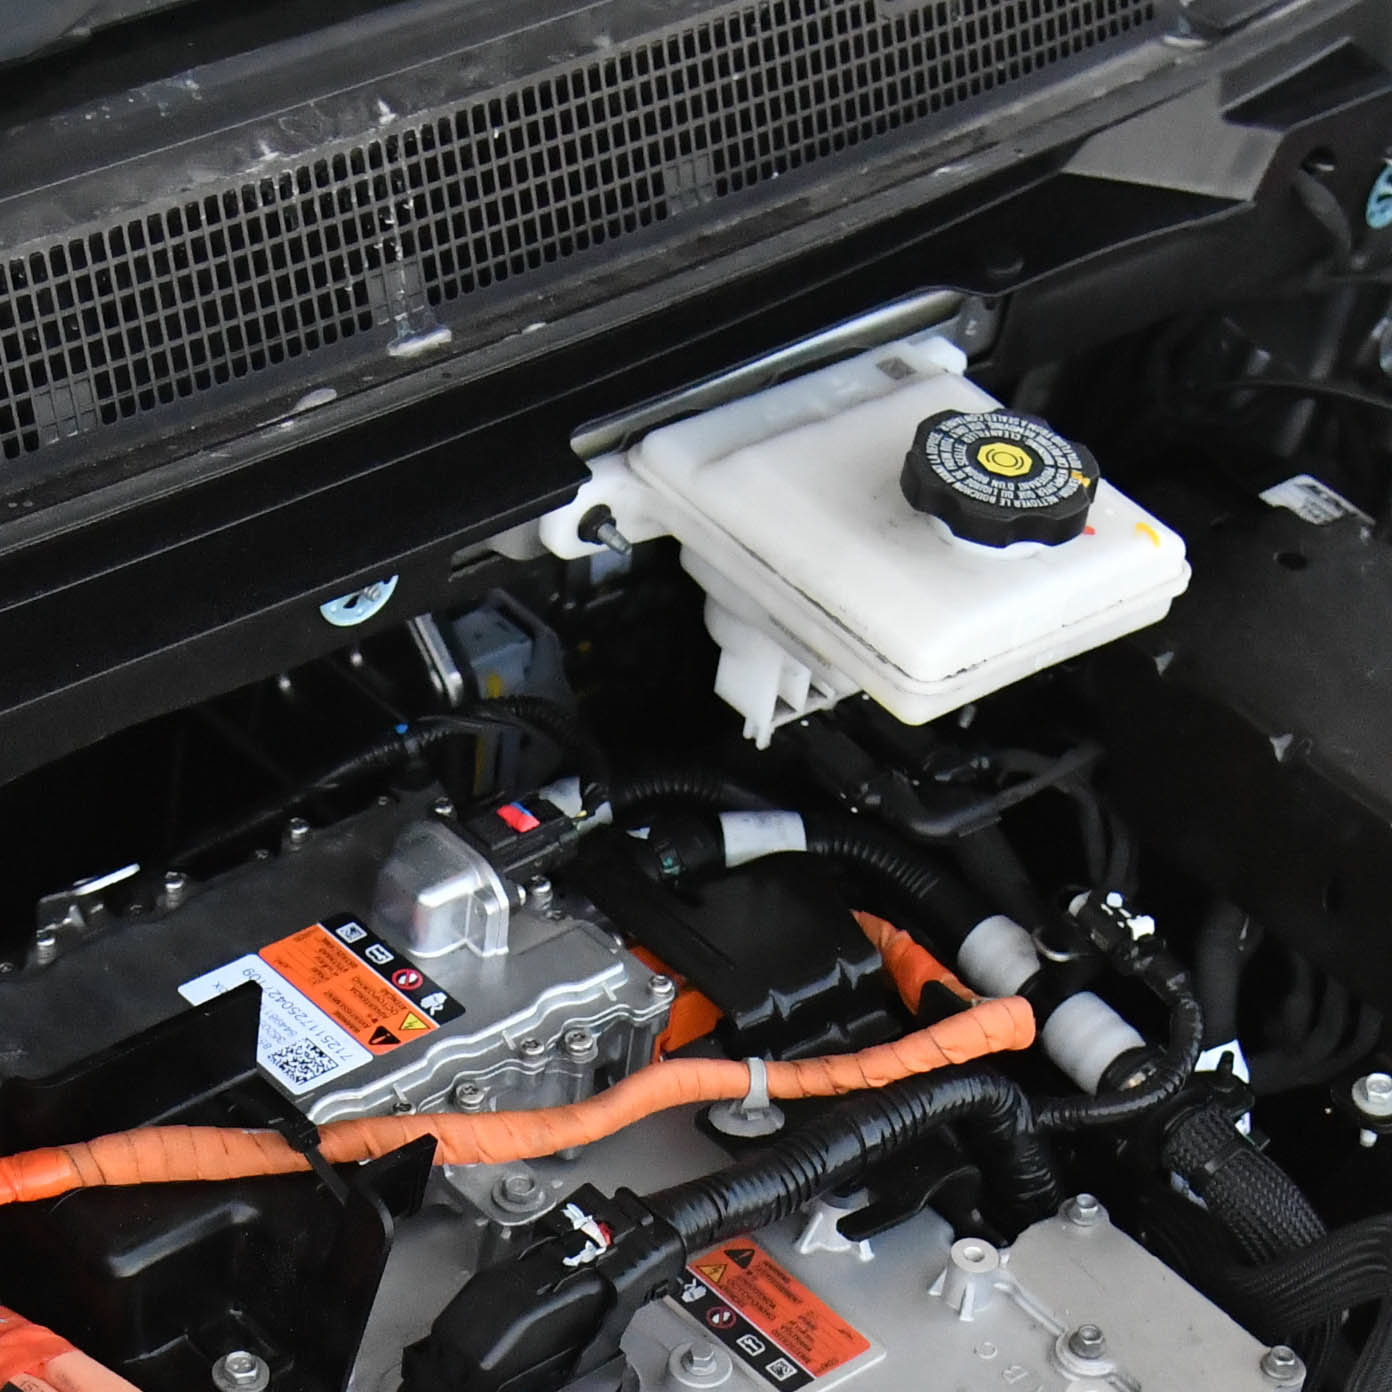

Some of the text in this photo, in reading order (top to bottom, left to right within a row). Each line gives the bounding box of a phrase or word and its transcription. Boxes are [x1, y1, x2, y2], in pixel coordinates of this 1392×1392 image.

[990, 430, 1020, 440] CLEAN
[925, 455, 940, 463] LA
[951, 481, 995, 503] BOUCHON
[1000, 490, 1013, 498] DU
[999, 497, 1010, 506] LE
